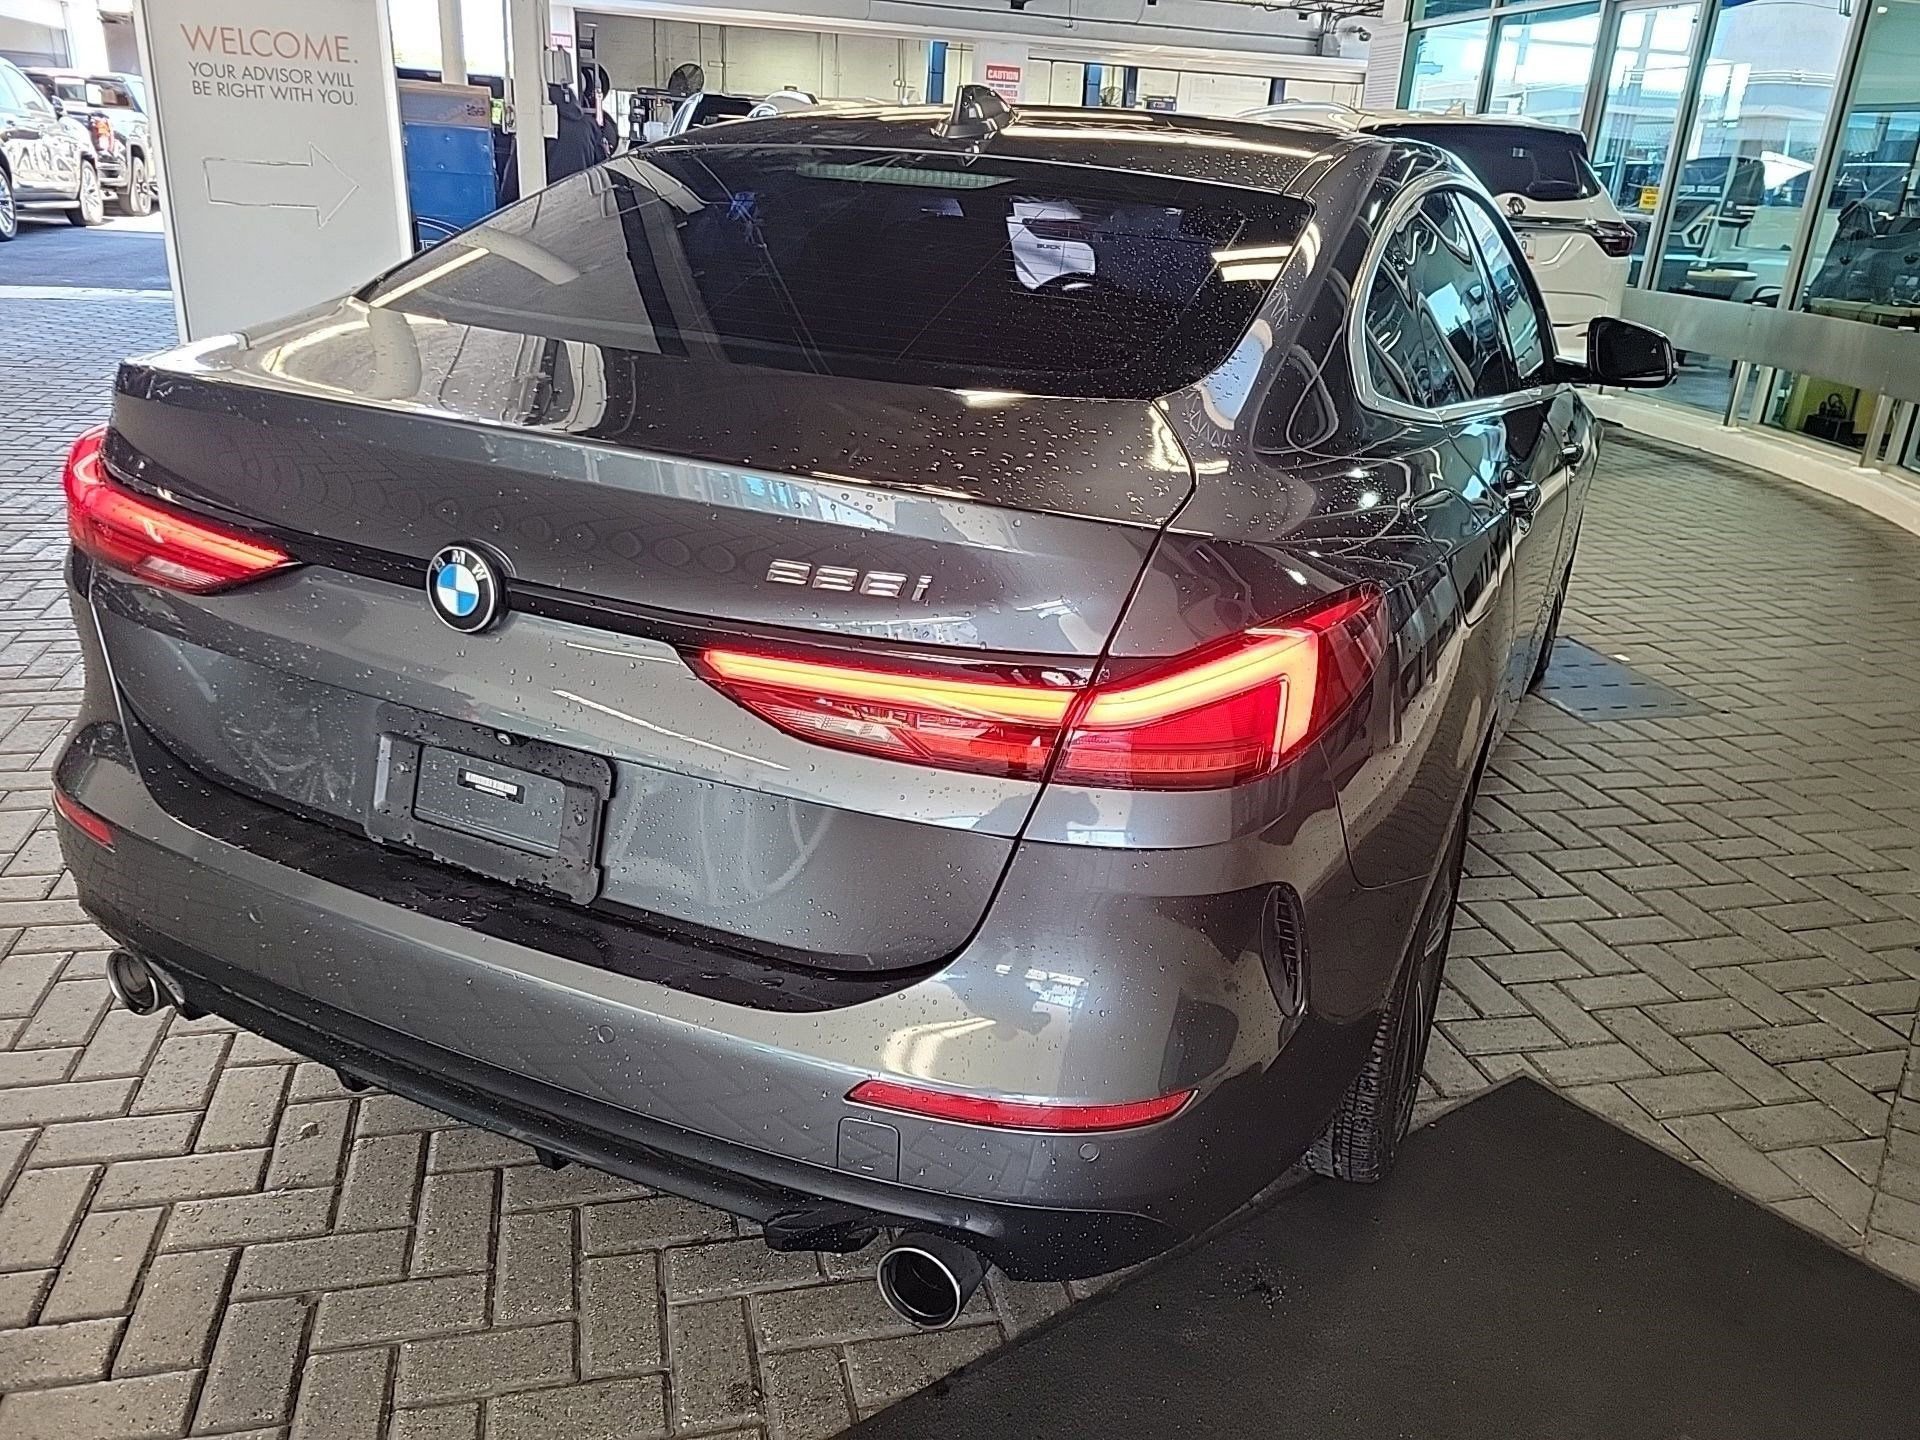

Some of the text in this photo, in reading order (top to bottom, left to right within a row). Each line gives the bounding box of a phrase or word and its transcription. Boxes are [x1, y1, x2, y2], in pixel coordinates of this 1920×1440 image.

[180, 23, 359, 64] WELCOME.
[188, 61, 354, 88] YOUR ADVISOR WILL
[987, 69, 1019, 81] CAUTION
[192, 80, 358, 106] BE RIGHT WITH YOU.
[432, 549, 488, 582] BMW
[766, 558, 933, 601] 228i
